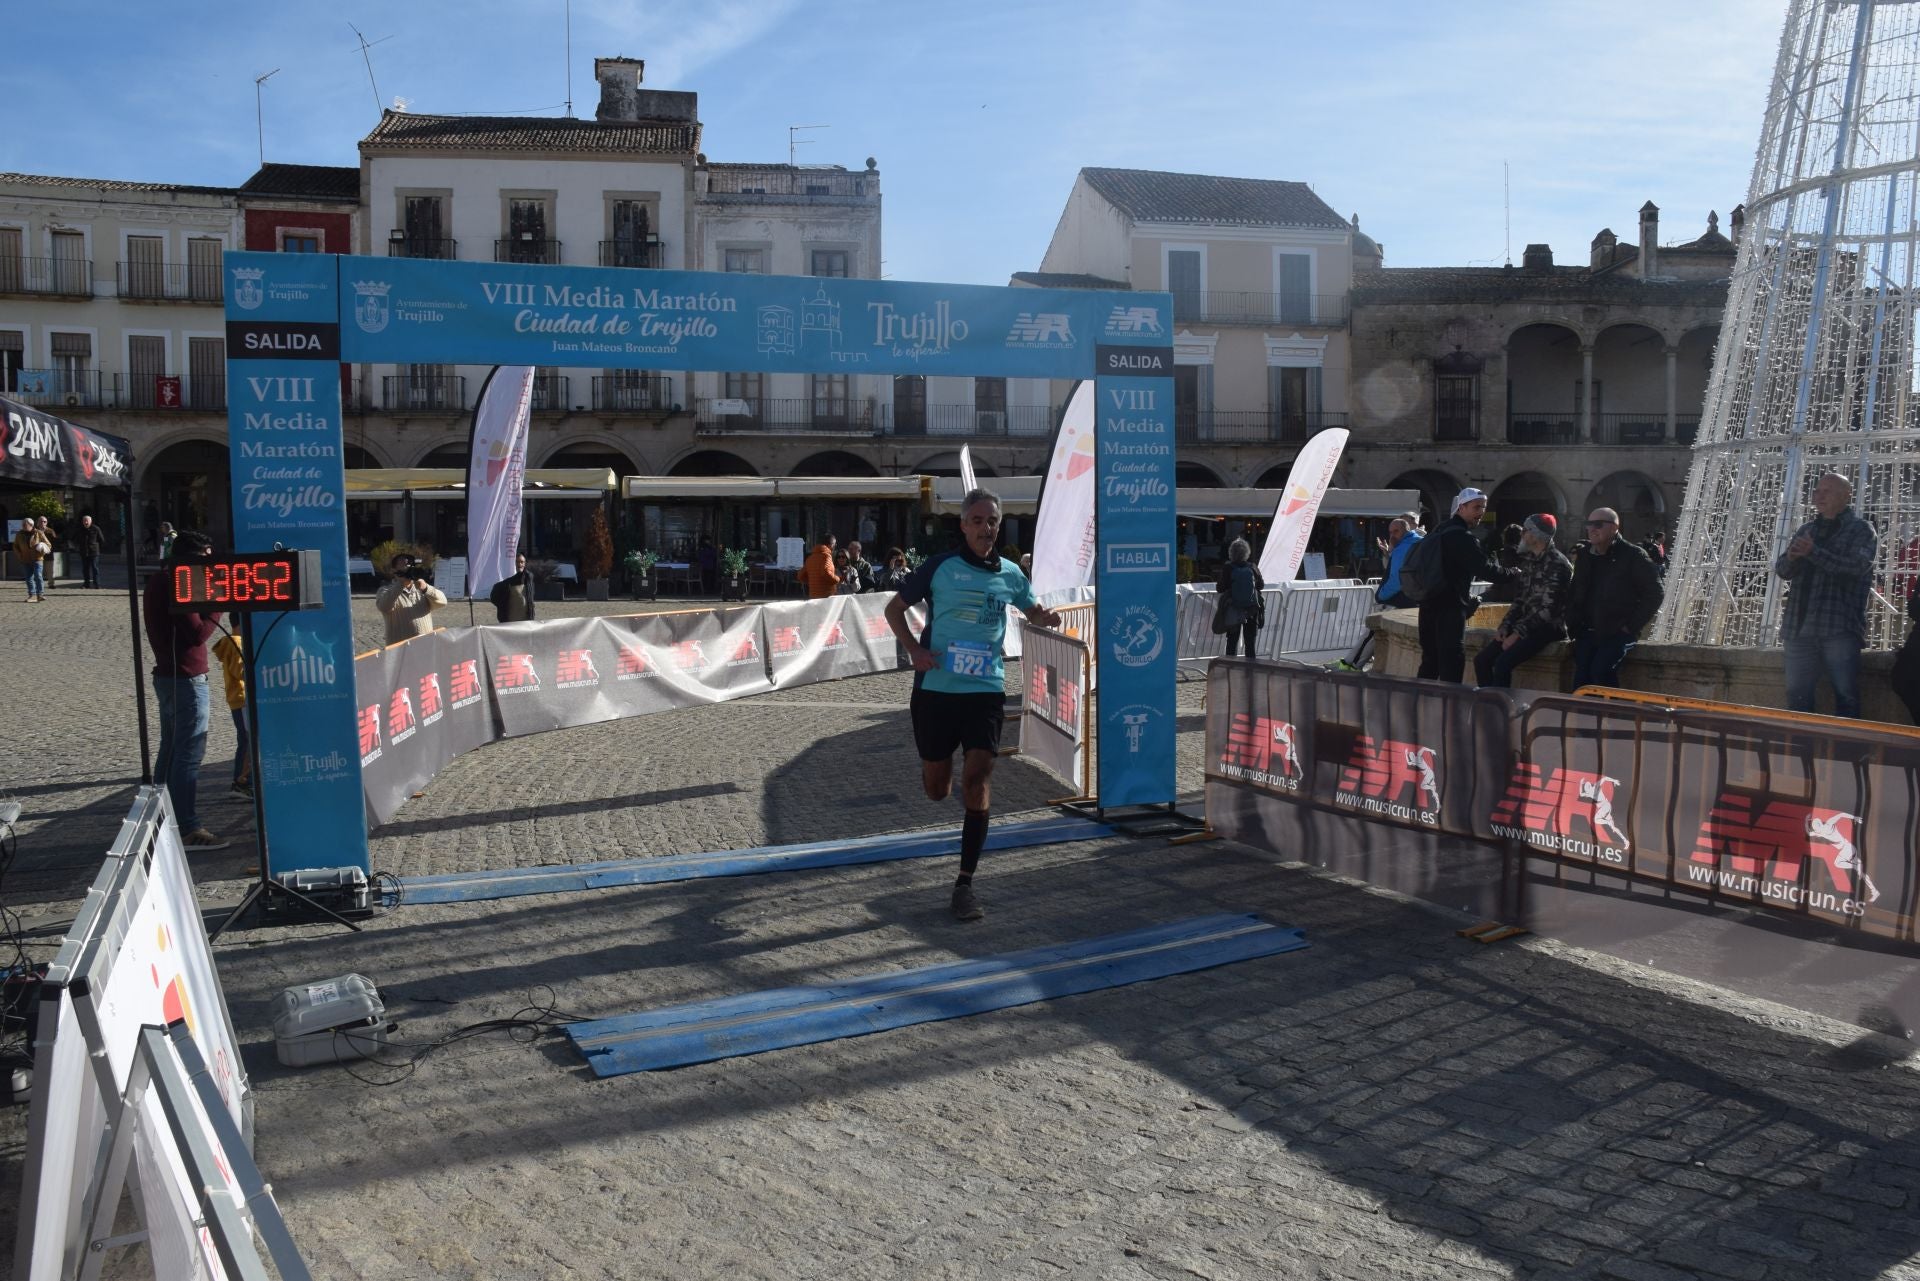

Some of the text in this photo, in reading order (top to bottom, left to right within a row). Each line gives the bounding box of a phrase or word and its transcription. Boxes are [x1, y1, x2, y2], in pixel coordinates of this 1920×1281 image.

[268, 290, 309, 301] Trujillo
[396, 299, 468, 310] Ayuntamiento de
[480, 282, 738, 312] VIII Media Maratón
[396, 309, 444, 324] Trujillo
[867, 300, 969, 349] Trujillo
[514, 310, 718, 345] Ciudad de Trujillo
[245, 332, 322, 350] SALIDA
[551, 341, 678, 354] Juan Mateos Broncano
[1109, 354, 1162, 369] SALIDA
[247, 377, 316, 402] VIII
[1109, 389, 1156, 410] VIII
[244, 412, 328, 430] Media
[1107, 418, 1165, 433] Media
[240, 441, 336, 458] Maratón
[1103, 442, 1169, 455] Maratón
[253, 466, 322, 480] Ciudad de
[1112, 461, 1145, 473] Ciudad
[1104, 475, 1169, 504] Trujillo
[241, 483, 335, 518] Trujillo
[1116, 551, 1161, 564] HABLA
[262, 645, 336, 692] trujillo
[953, 653, 984, 676] 522
[301, 750, 347, 774] Trujillo
[1220, 762, 1297, 791] www.musicrun.es
[1336, 790, 1435, 825] www.musicrun.es
[1491, 822, 1622, 864] www.musicrun.es
[1689, 862, 1867, 918] www.musicrun.es
